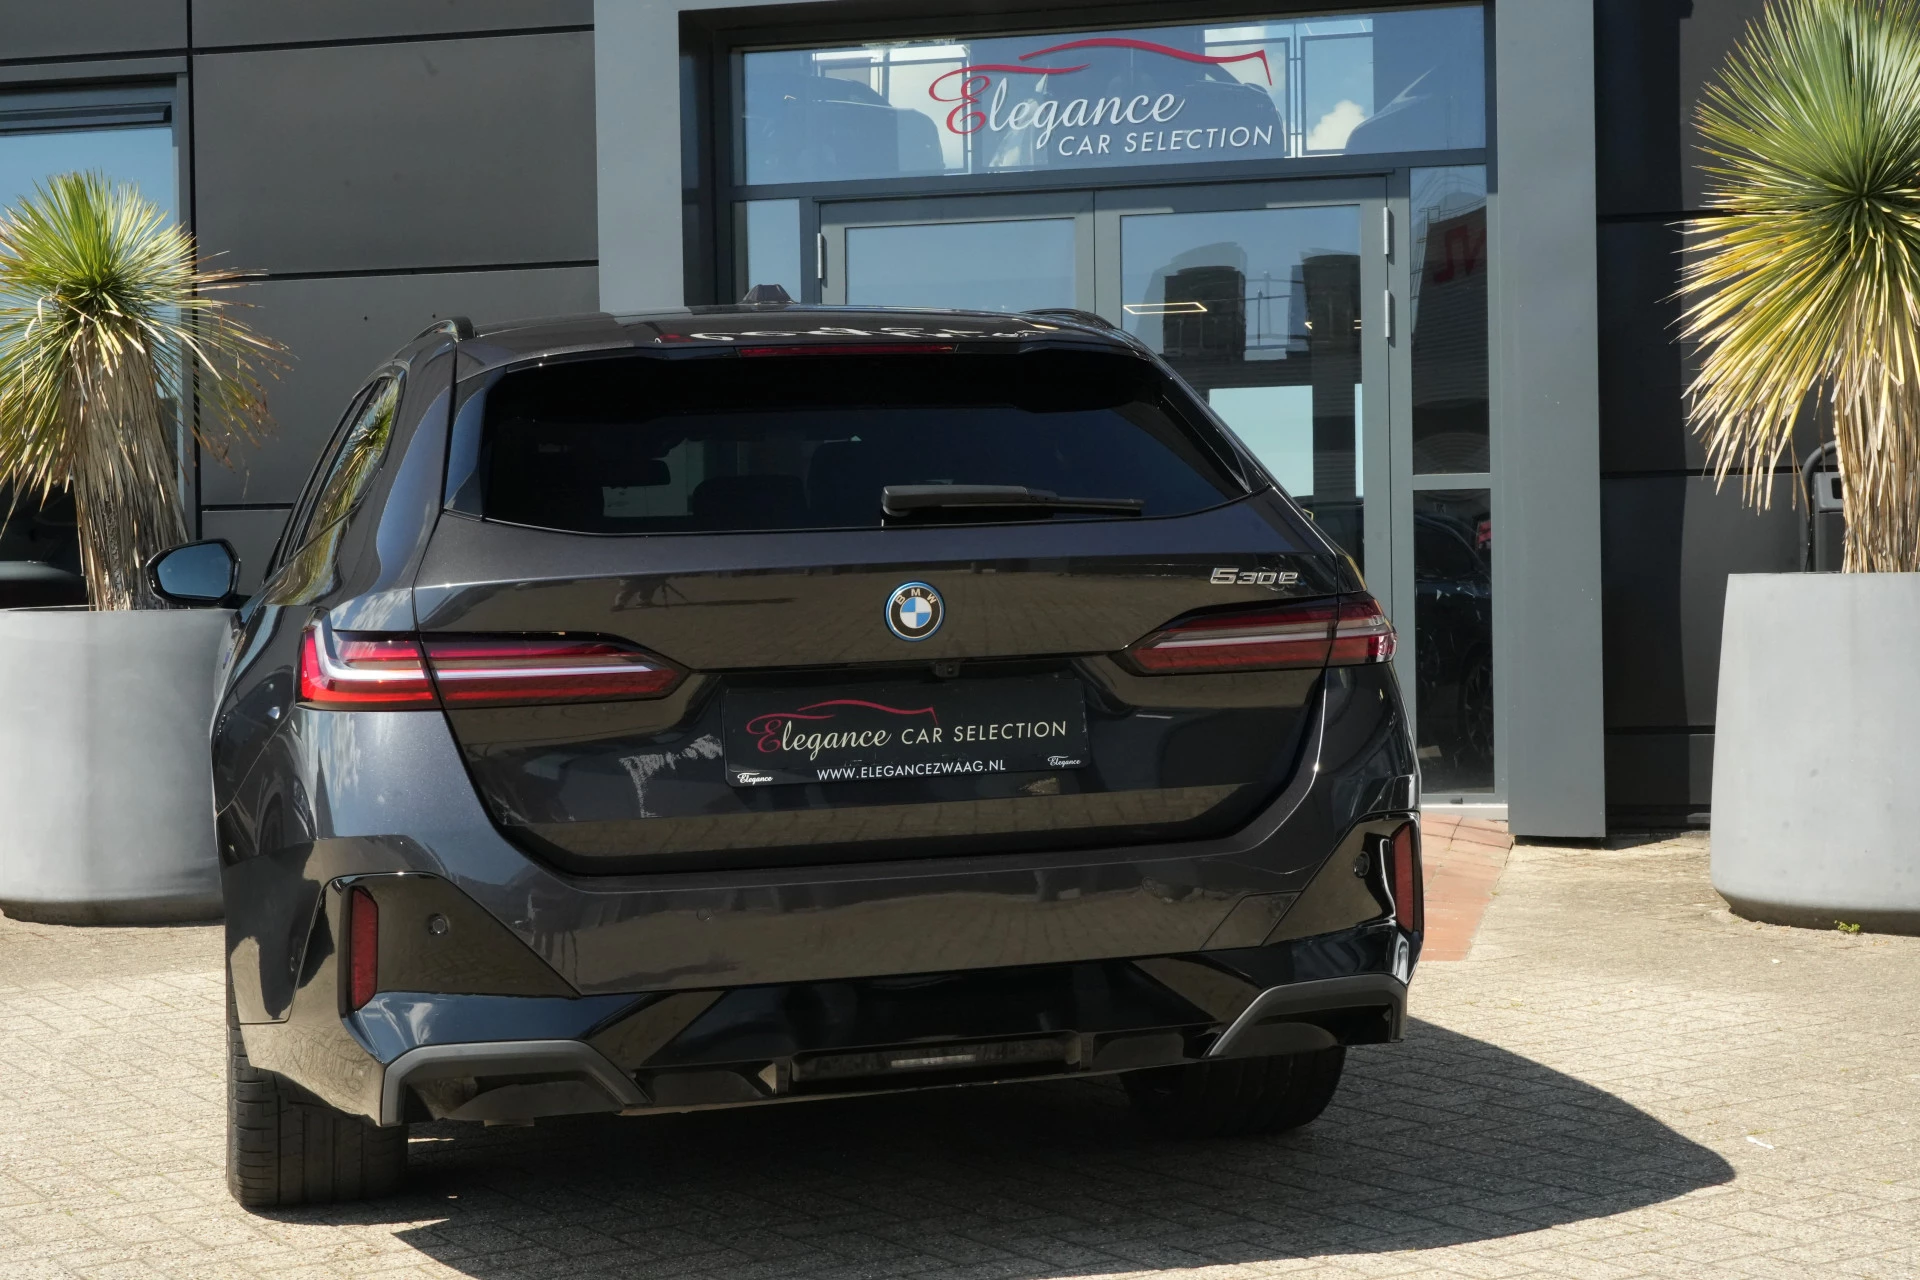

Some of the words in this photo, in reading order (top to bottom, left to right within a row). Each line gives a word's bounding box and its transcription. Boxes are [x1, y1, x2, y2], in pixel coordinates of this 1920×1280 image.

[929, 64, 1186, 150] Elegance
[1058, 135, 1110, 157] CAR
[1124, 125, 1274, 154] SELECTION
[1210, 567, 1299, 585] 530e
[894, 588, 937, 606] BMW
[746, 713, 892, 761] Elegance
[901, 727, 944, 746] CAR
[953, 720, 1068, 743] SELECTION
[817, 759, 1006, 781] WWW.ELEGANCEZWAAG.NL
[1047, 755, 1081, 768] Elegance
[737, 772, 774, 785] Elegance
